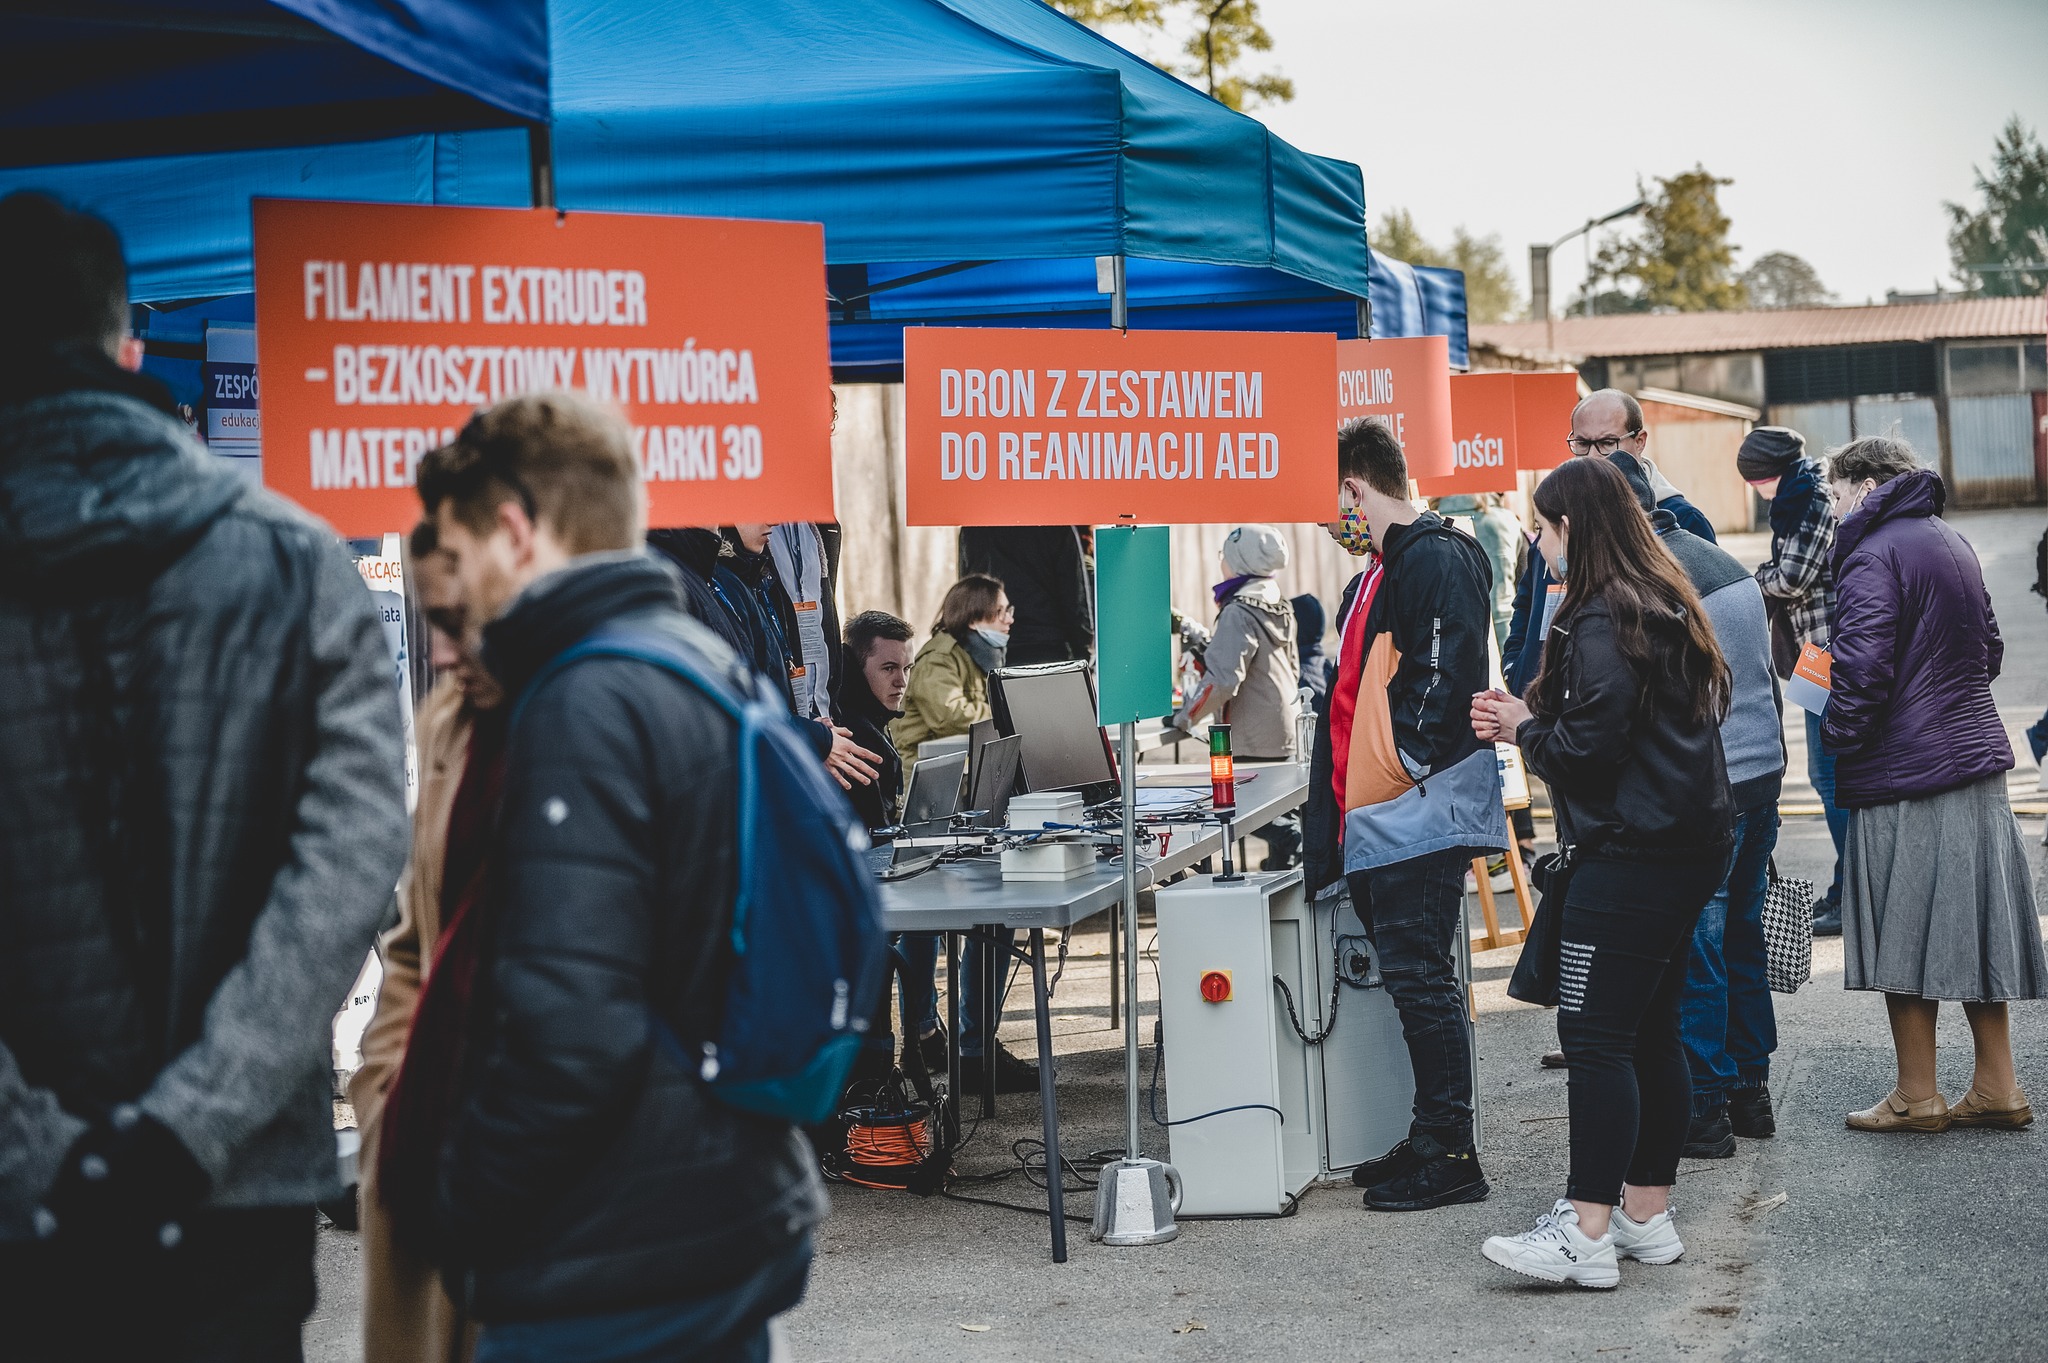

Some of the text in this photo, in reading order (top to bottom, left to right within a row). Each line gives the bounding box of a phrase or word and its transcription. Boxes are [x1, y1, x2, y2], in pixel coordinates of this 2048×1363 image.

[304, 262, 647, 326] FILAMENT EXTRUDER
[215, 368, 259, 399] ZESPÓ
[333, 345, 578, 405] BEZKOSZTOWY
[581, 337, 759, 405] WYTWÓRCA
[940, 368, 1263, 419] DRON Z ZESTAWEM
[1338, 367, 1394, 407] CYCLING
[722, 424, 764, 481] 3D
[940, 431, 1280, 481] DO REANIMACJI AED
[1558, 1245, 1577, 1263] FILA
